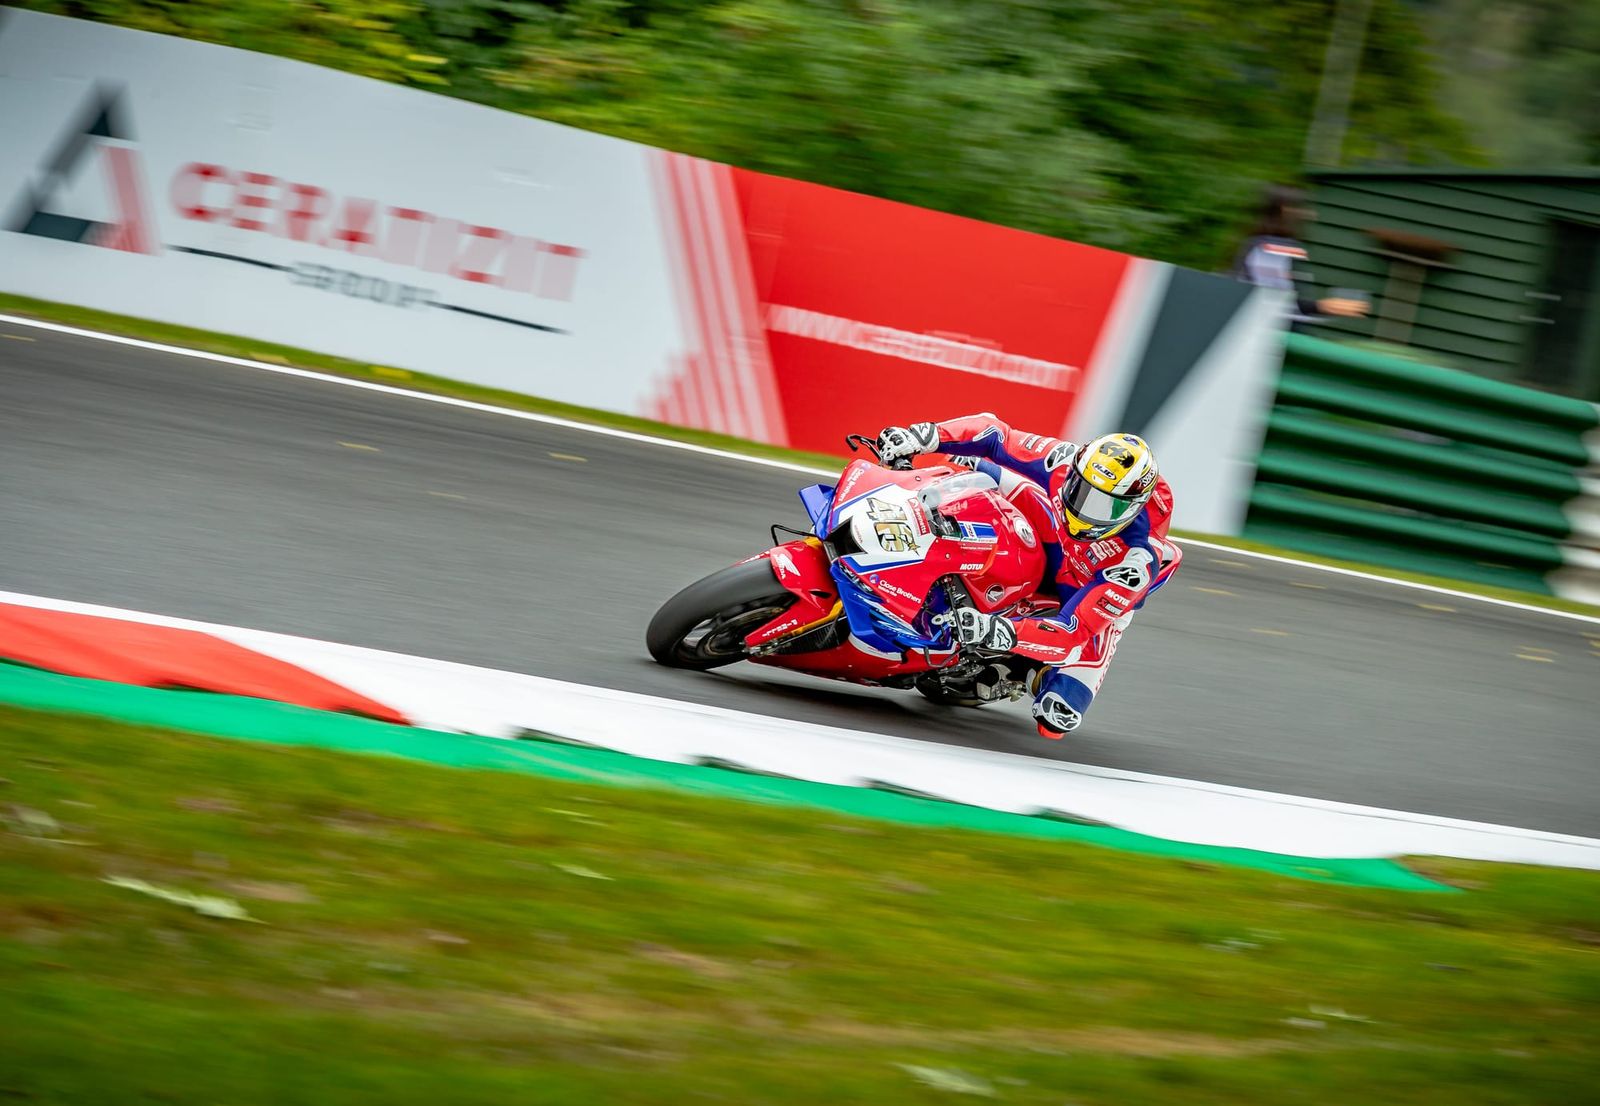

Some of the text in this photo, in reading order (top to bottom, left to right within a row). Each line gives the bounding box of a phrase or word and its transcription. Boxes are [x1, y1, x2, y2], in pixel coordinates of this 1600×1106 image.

[1094, 465, 1114, 479] HJC
[879, 579, 897, 592] Close
[896, 587, 922, 604] Brothers
